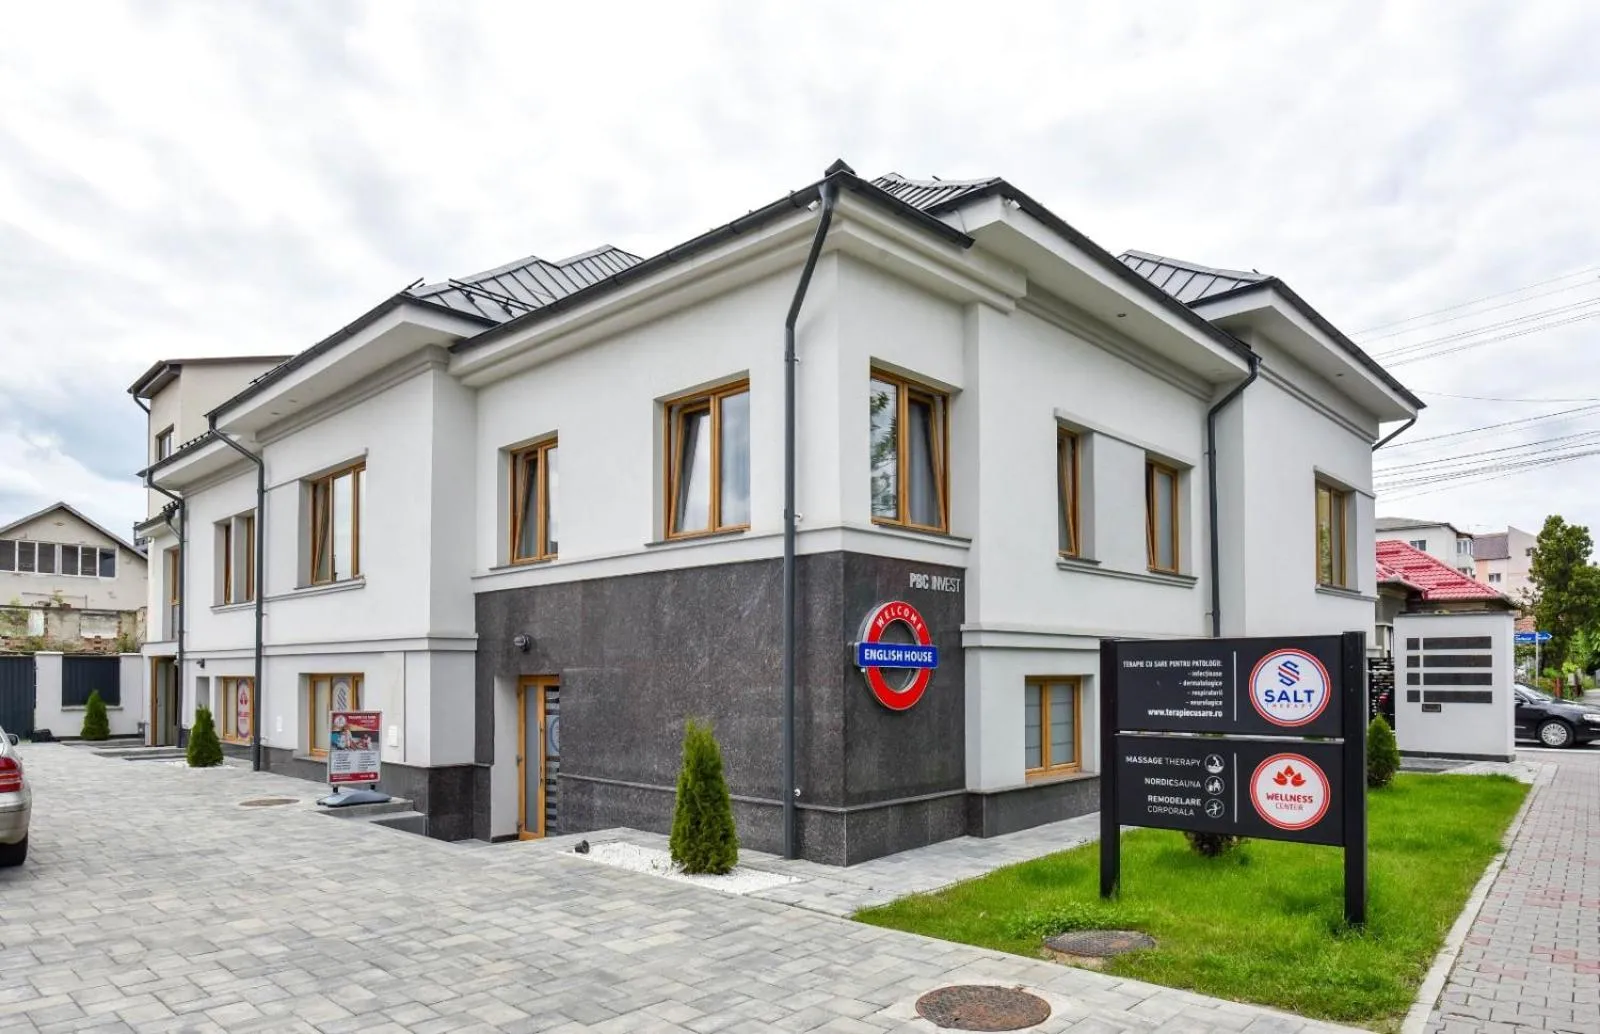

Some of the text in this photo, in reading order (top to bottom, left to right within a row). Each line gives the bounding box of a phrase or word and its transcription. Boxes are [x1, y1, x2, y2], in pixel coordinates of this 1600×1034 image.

[909, 572, 961, 592] PBC INVEST
[876, 605, 922, 630] WELCOME
[864, 649, 933, 662] ENGLISH HOUSE
[1264, 689, 1315, 703] SALT
[1147, 708, 1223, 718] www.terapiecusare.ro
[1125, 755, 1201, 767] MASSAGE THERAPY
[1144, 777, 1201, 788] NORDICSAUNA
[1147, 795, 1202, 806] REMODELARE
[1266, 792, 1314, 804] WELLNESS
[1275, 803, 1304, 811] CENTER
